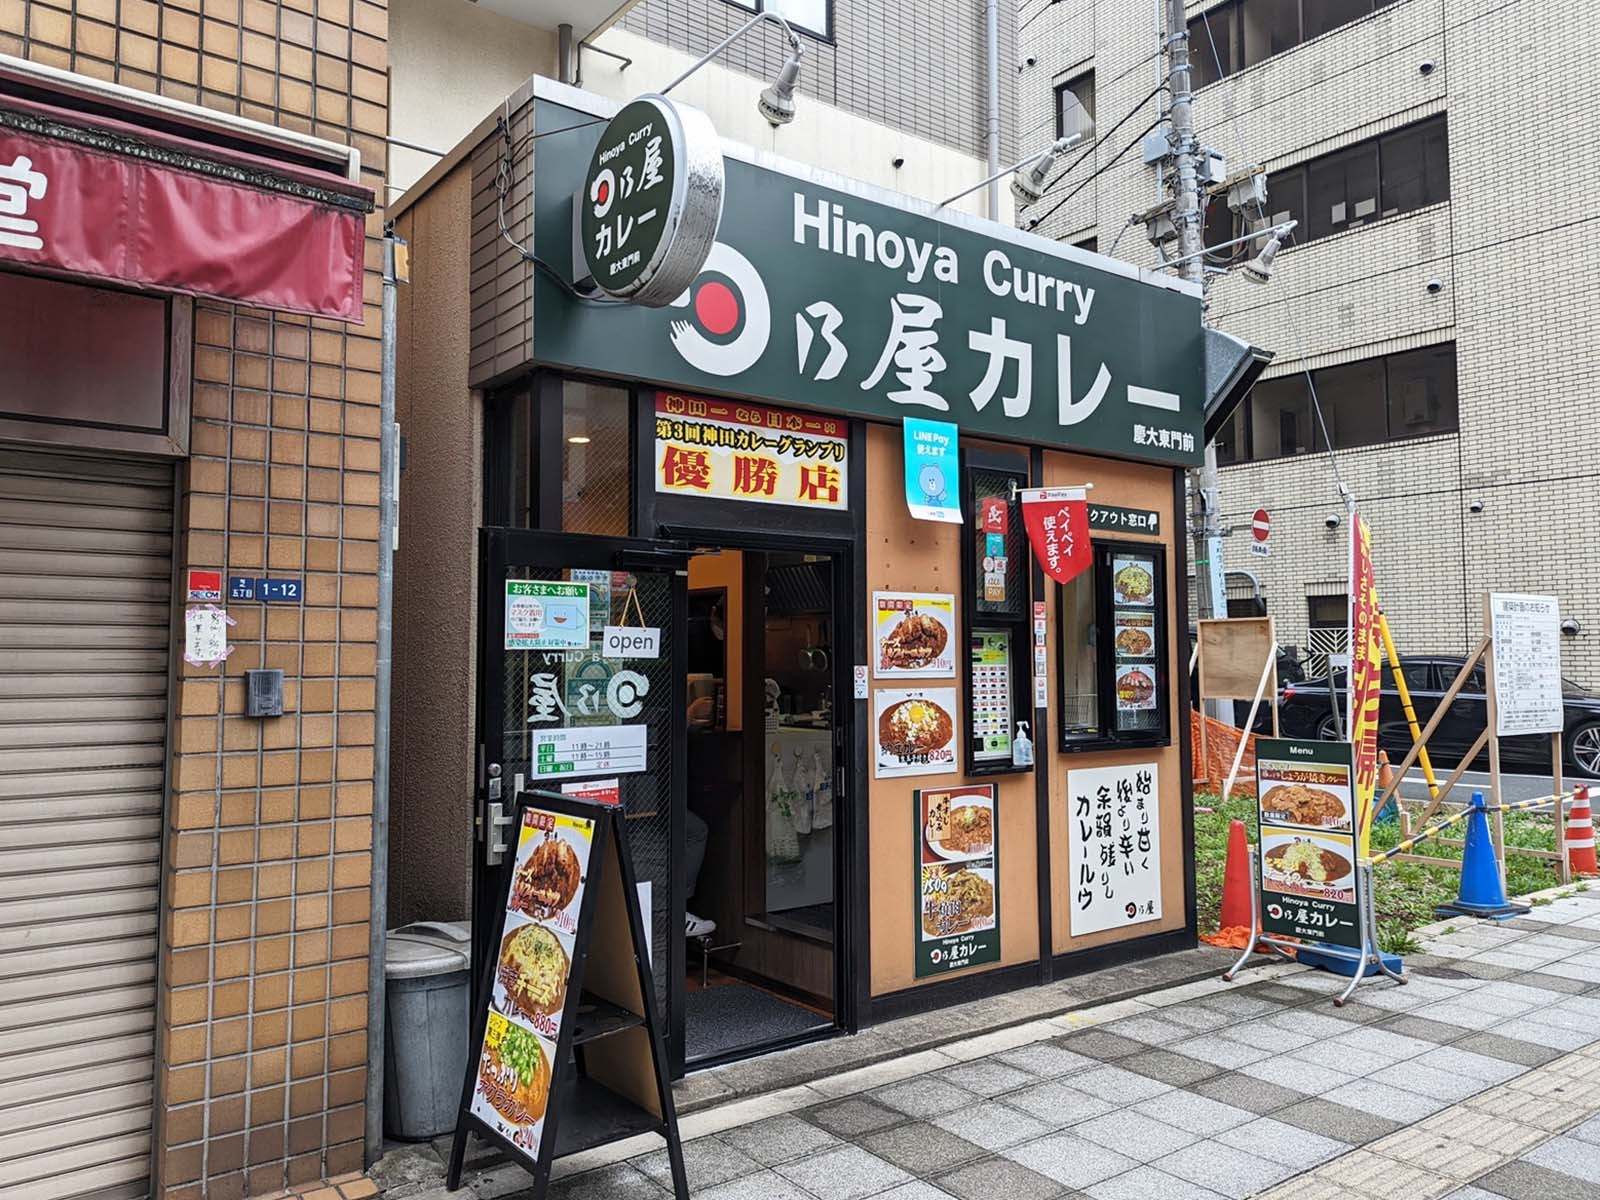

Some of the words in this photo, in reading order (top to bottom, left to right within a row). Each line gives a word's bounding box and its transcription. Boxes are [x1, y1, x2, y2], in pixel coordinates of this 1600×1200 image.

[600, 141, 625, 165] Hinoya
[629, 122, 653, 145] Curry
[595, 209, 656, 260] カレー
[793, 192, 959, 286] Hinoya
[983, 250, 1095, 326] Curry
[655, 417, 846, 461] 第3回神田カレーグランプリ
[913, 431, 932, 441] LINE
[932, 433, 949, 446] Pay
[917, 443, 946, 457] 使えます
[1132, 423, 1195, 453] 慶大東門前
[661, 444, 841, 503] 優勝店
[1058, 505, 1074, 557] ペイペイ
[1087, 507, 1148, 529] クアウト窓口
[1043, 516, 1063, 573] 使えます。
[263, 583, 297, 597] 1-12
[512, 583, 584, 596] お客さまへお願い
[609, 635, 654, 654] open
[929, 749, 953, 761] 820円
[1289, 746, 1314, 755] Menu
[1136, 770, 1152, 870] 始まり甘く
[1076, 794, 1095, 912] カレールウ
[1281, 896, 1309, 907] Hinoya
[1311, 901, 1336, 912] Curry
[1323, 888, 1344, 900] 820
[482, 1051, 519, 1093] たっぷり
